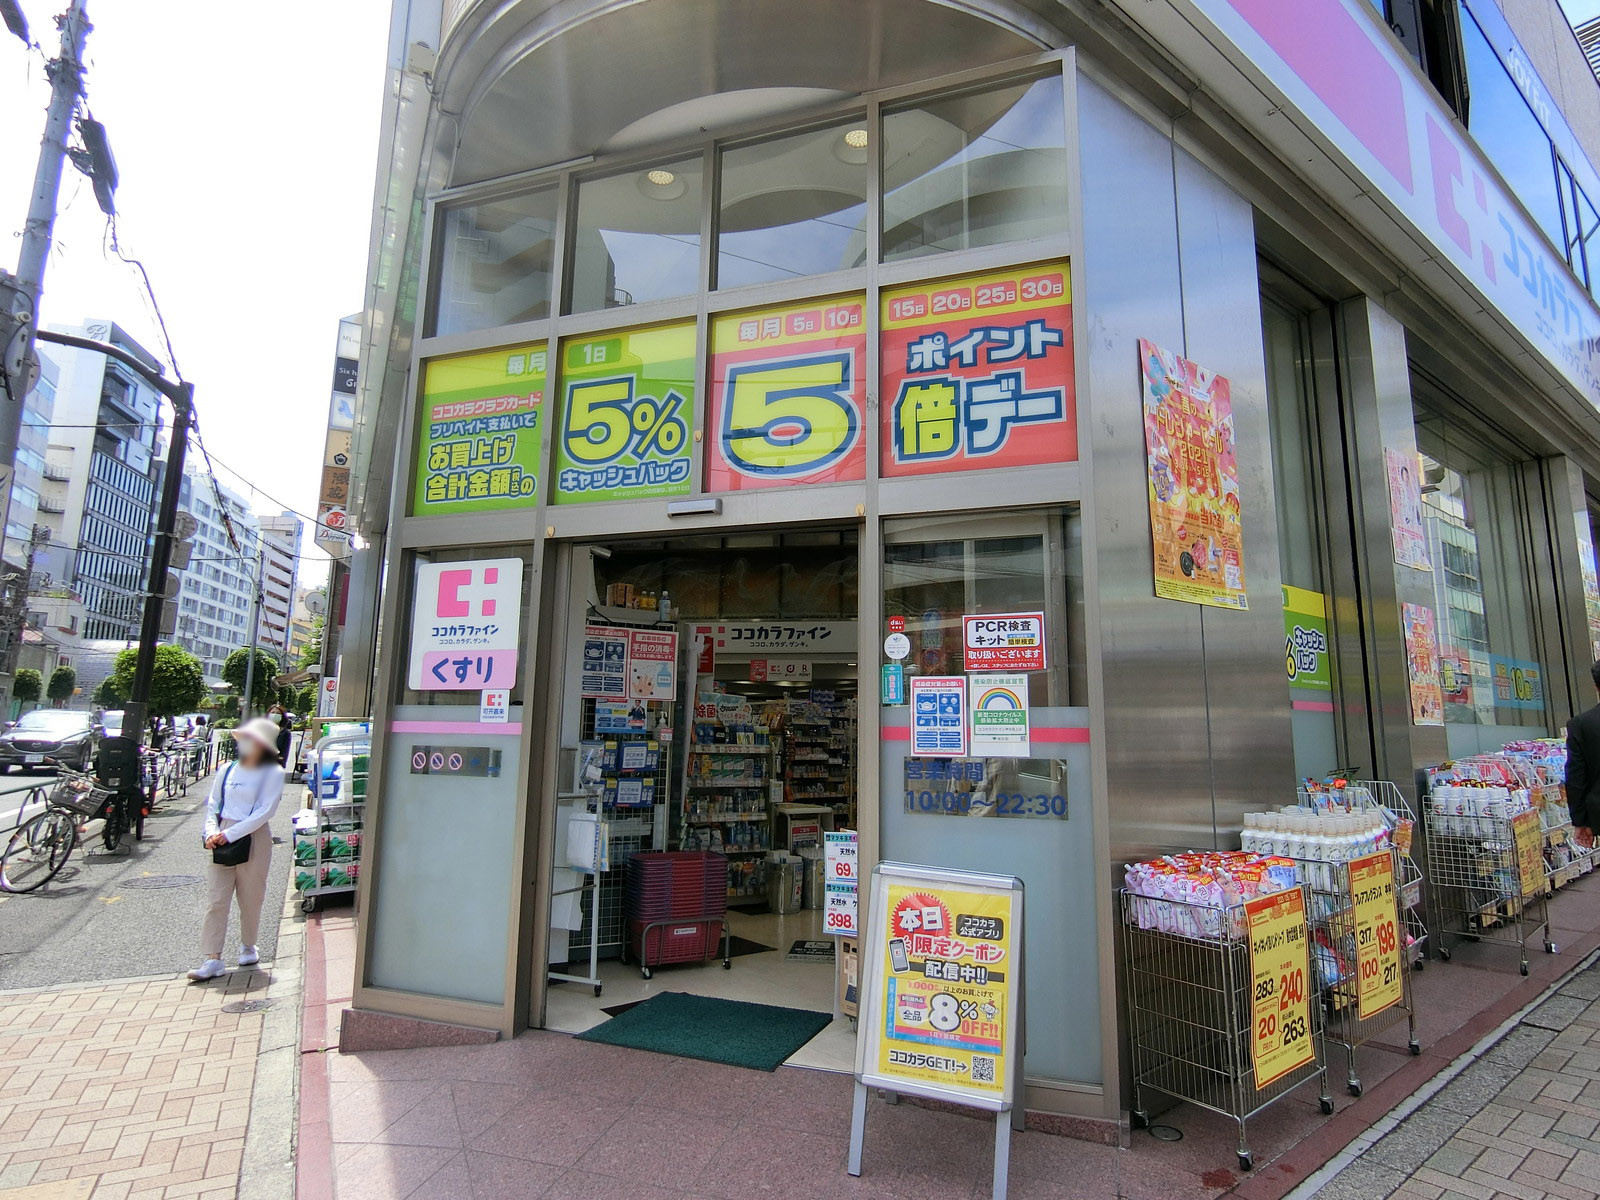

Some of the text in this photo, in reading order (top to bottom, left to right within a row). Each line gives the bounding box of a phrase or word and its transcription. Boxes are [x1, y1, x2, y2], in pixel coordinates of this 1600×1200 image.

[893, 279, 1063, 317] 15日 20日 25日 30日
[739, 309, 858, 341] 毎月 5日 10日
[583, 343, 606, 364] 1日
[907, 319, 1064, 374] ポイント
[507, 352, 547, 376] 毎月
[563, 374, 688, 466] 5%
[720, 347, 1066, 479] 5 倍デー
[430, 411, 536, 440] プリペイド支払いで
[427, 433, 517, 471] お買上げ
[559, 457, 691, 491] キャッシュバック
[431, 624, 499, 638] ココカラファイン
[731, 626, 832, 640] ココカラファイン
[975, 620, 1032, 633] PCR検査
[438, 638, 491, 646] ココロ、カラダ、ゲンキ。
[975, 635, 1005, 646] キット
[967, 649, 1041, 659] 取り扱いございます
[432, 656, 493, 684] くすり
[840, 847, 856, 855] 天然水
[836, 862, 851, 876] 69
[830, 897, 847, 906] 天然水
[827, 912, 852, 928] 398
[898, 905, 943, 932] 本日
[964, 917, 996, 928] ココカラ
[960, 926, 1000, 939] 公式アプリ
[1359, 927, 1371, 945] 317
[1376, 920, 1395, 956] 198
[914, 935, 1003, 962] 限定クーポン
[925, 960, 986, 984] 配信中!!
[1361, 957, 1378, 980] 100
[1384, 962, 1396, 985] 217
[1255, 977, 1274, 1001] 283
[1280, 968, 1303, 1011] 240
[903, 1009, 922, 1022] 全品
[928, 991, 979, 1032] 8%
[961, 1020, 999, 1039] OFF!!
[1259, 1013, 1276, 1040] 20
[1283, 1016, 1305, 1046] 263
[890, 1050, 956, 1072] ココカラGET!
